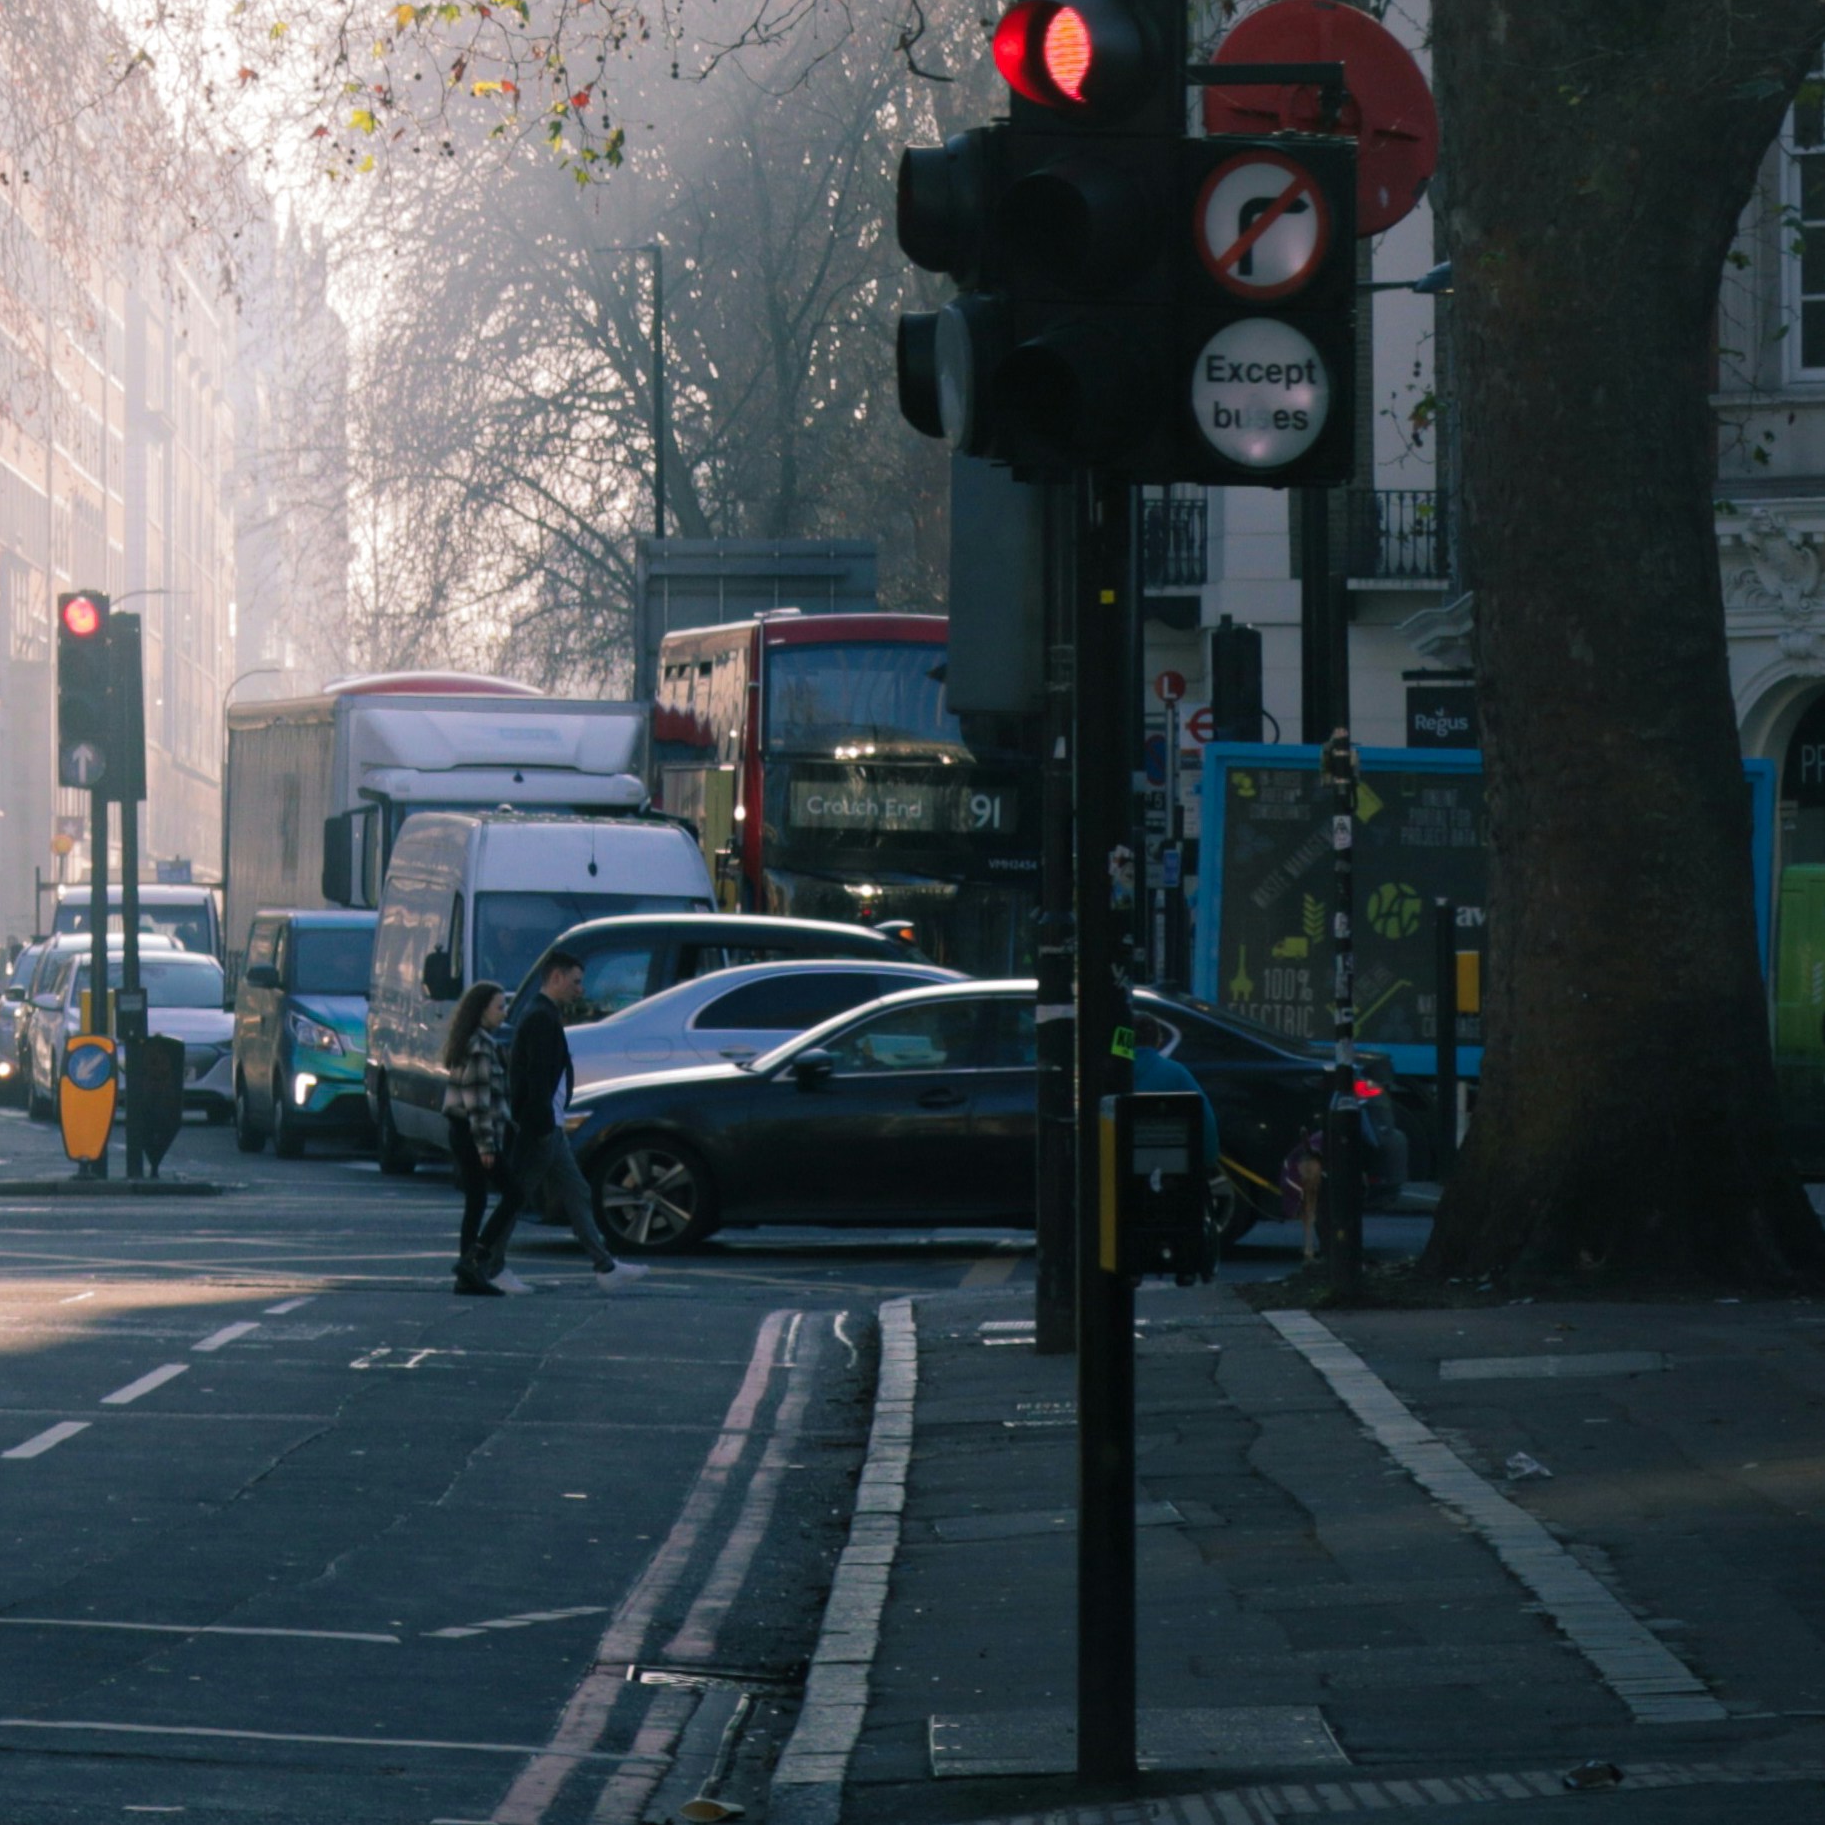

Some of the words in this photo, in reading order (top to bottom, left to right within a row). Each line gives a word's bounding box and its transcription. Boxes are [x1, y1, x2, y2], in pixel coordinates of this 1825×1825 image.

[1206, 354, 1317, 390] Except
[1214, 401, 1308, 431] bues
[1162, 675, 1177, 699] L
[1414, 713, 1469, 736] Regus
[806, 795, 879, 816] Crouch
[885, 797, 923, 819] End
[970, 794, 1001, 829] 91
[1264, 968, 1314, 1001] 100%
[1227, 1002, 1315, 1039] CTRIC
